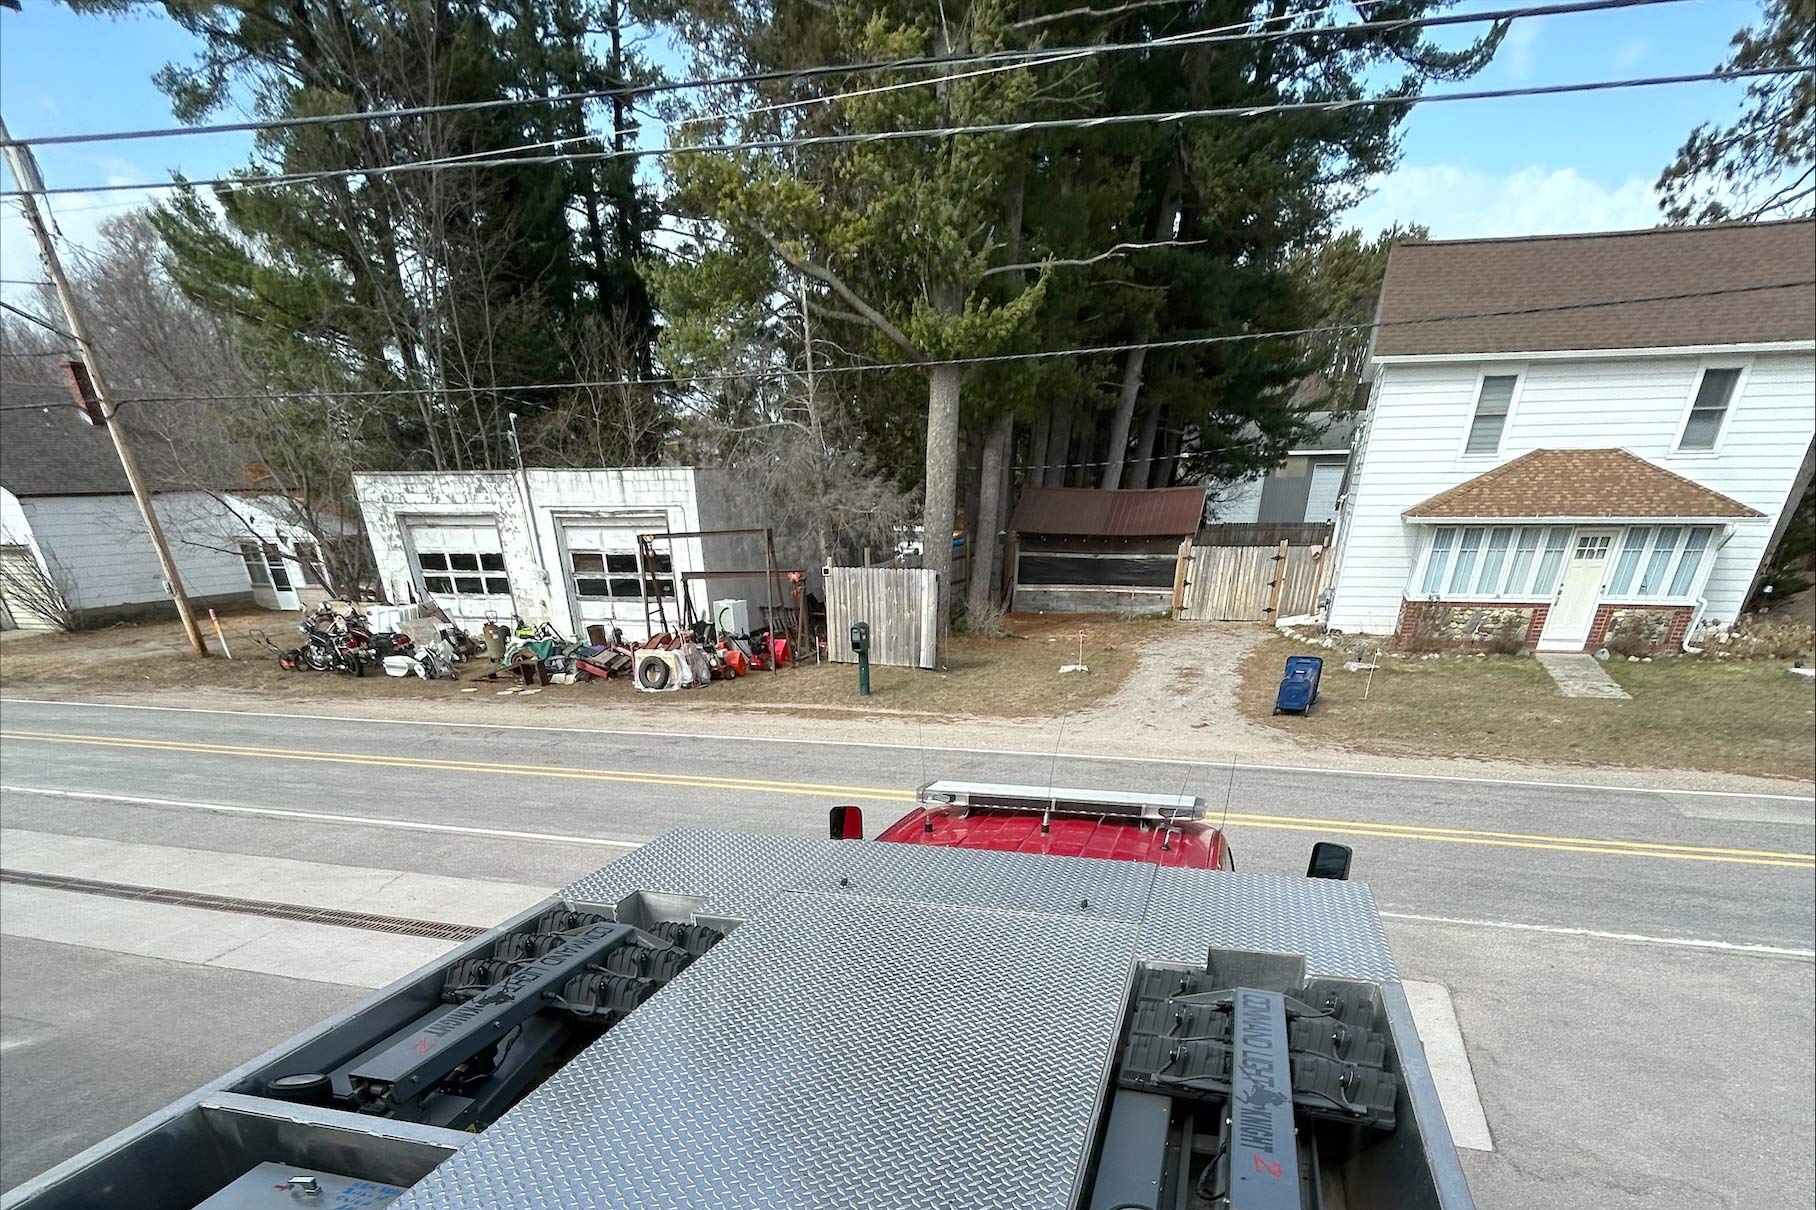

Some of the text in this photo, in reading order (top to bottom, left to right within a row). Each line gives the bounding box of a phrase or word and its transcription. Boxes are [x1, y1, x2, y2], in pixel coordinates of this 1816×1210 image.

[540, 926, 615, 965] COMMAND
[499, 966, 552, 992] LIGHT
[423, 1005, 484, 1037] KNIGHT
[1240, 994, 1284, 1178] COMMAND LIGHT KNIGHT 2
